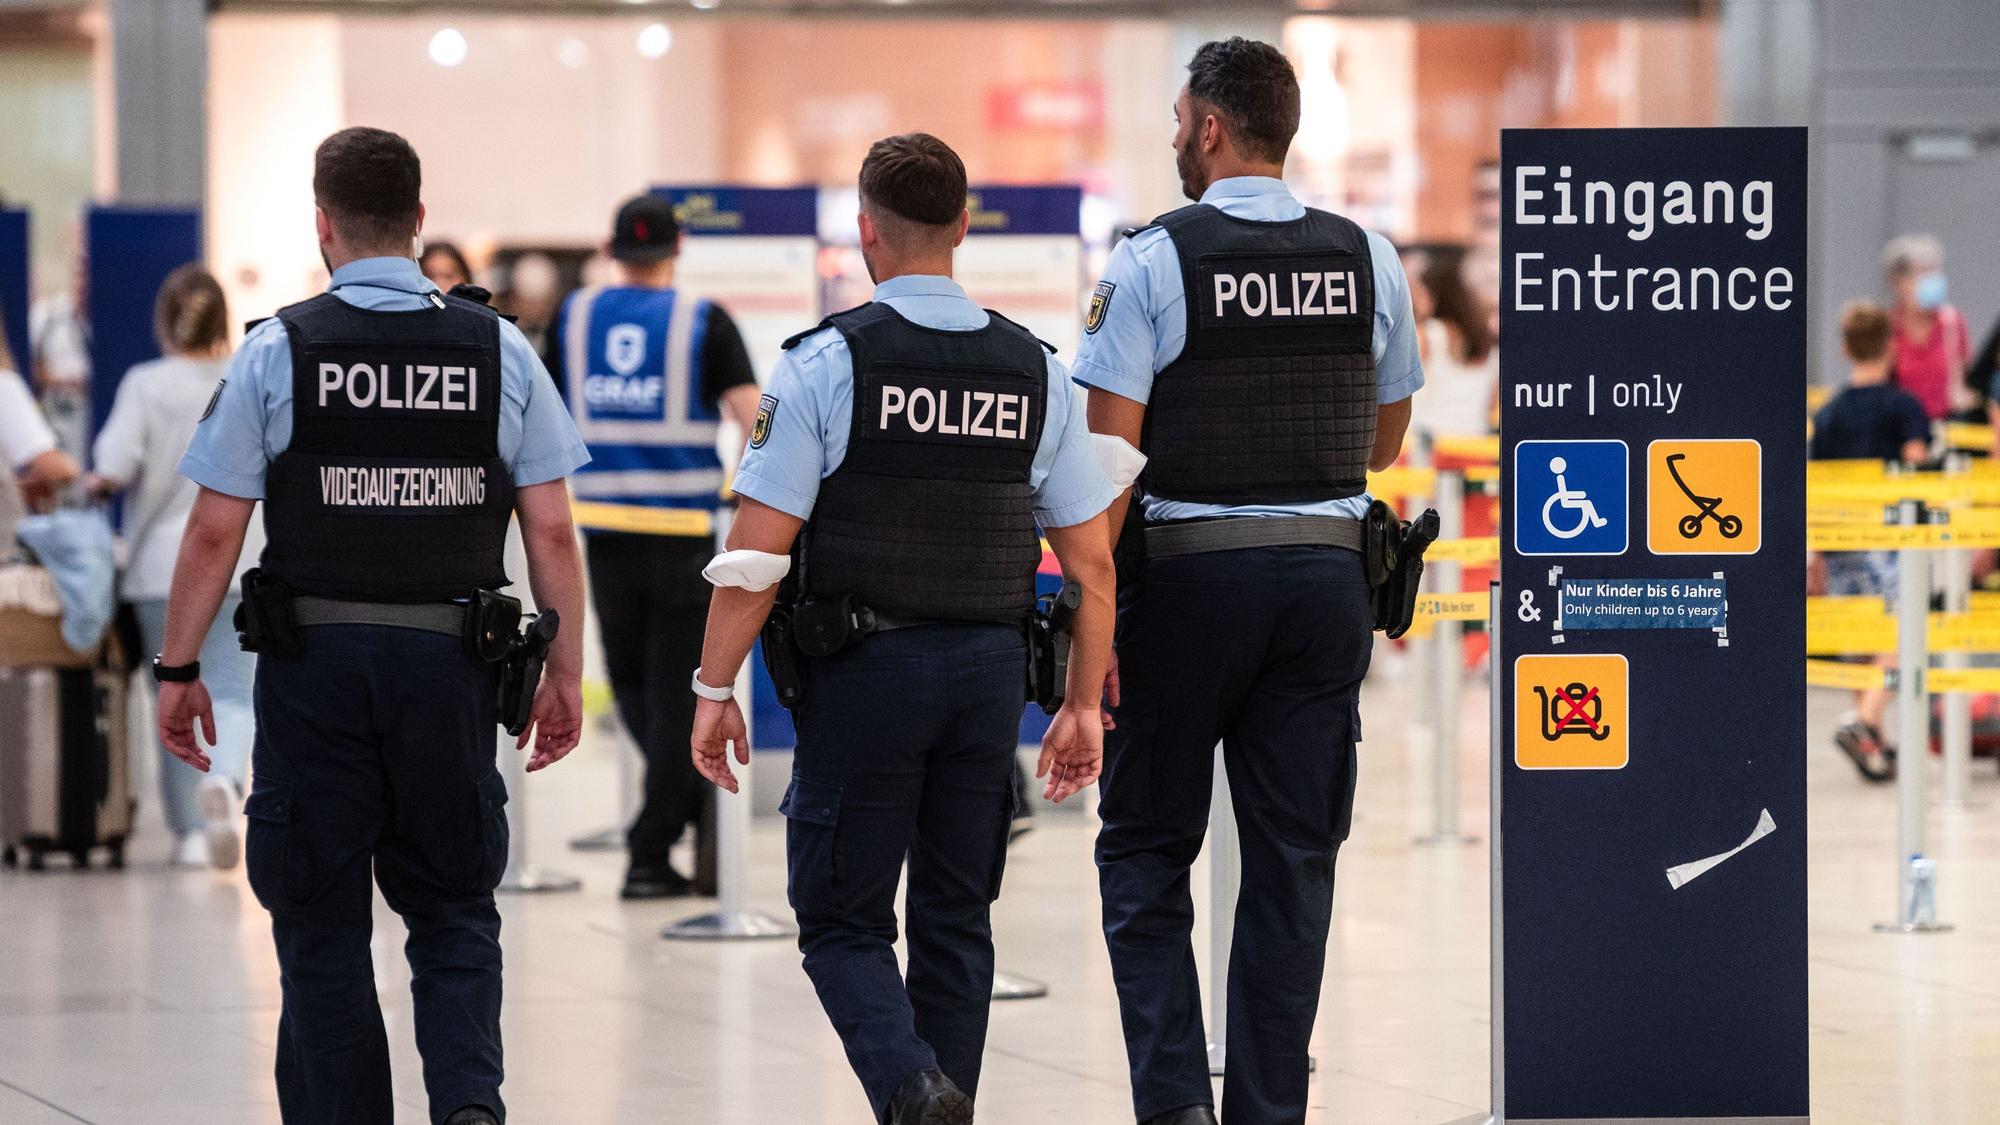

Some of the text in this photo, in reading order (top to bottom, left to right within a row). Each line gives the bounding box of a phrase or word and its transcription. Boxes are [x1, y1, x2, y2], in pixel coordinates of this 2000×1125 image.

[1515, 165, 1774, 241] Eingang
[1213, 271, 1358, 318] POLIZEI
[1515, 252, 1794, 312] Entrance
[318, 362, 478, 412] POLIZEI
[584, 374, 663, 406] GRAF
[1515, 381, 1573, 408] nur
[1612, 374, 1683, 414] only
[879, 385, 1029, 440] POLIZEI
[320, 465, 486, 508] VIDEOAUFZEICHNUNG
[1517, 589, 1542, 622] &
[1565, 603, 1592, 618] Only
[1594, 603, 1641, 616] children
[1644, 606, 1660, 618] up
[1662, 605, 1675, 616] to
[1677, 604, 1685, 616] 6
[1687, 607, 1718, 618] years
[1566, 584, 1722, 598] Nur Kinder bis 6 Jahre
